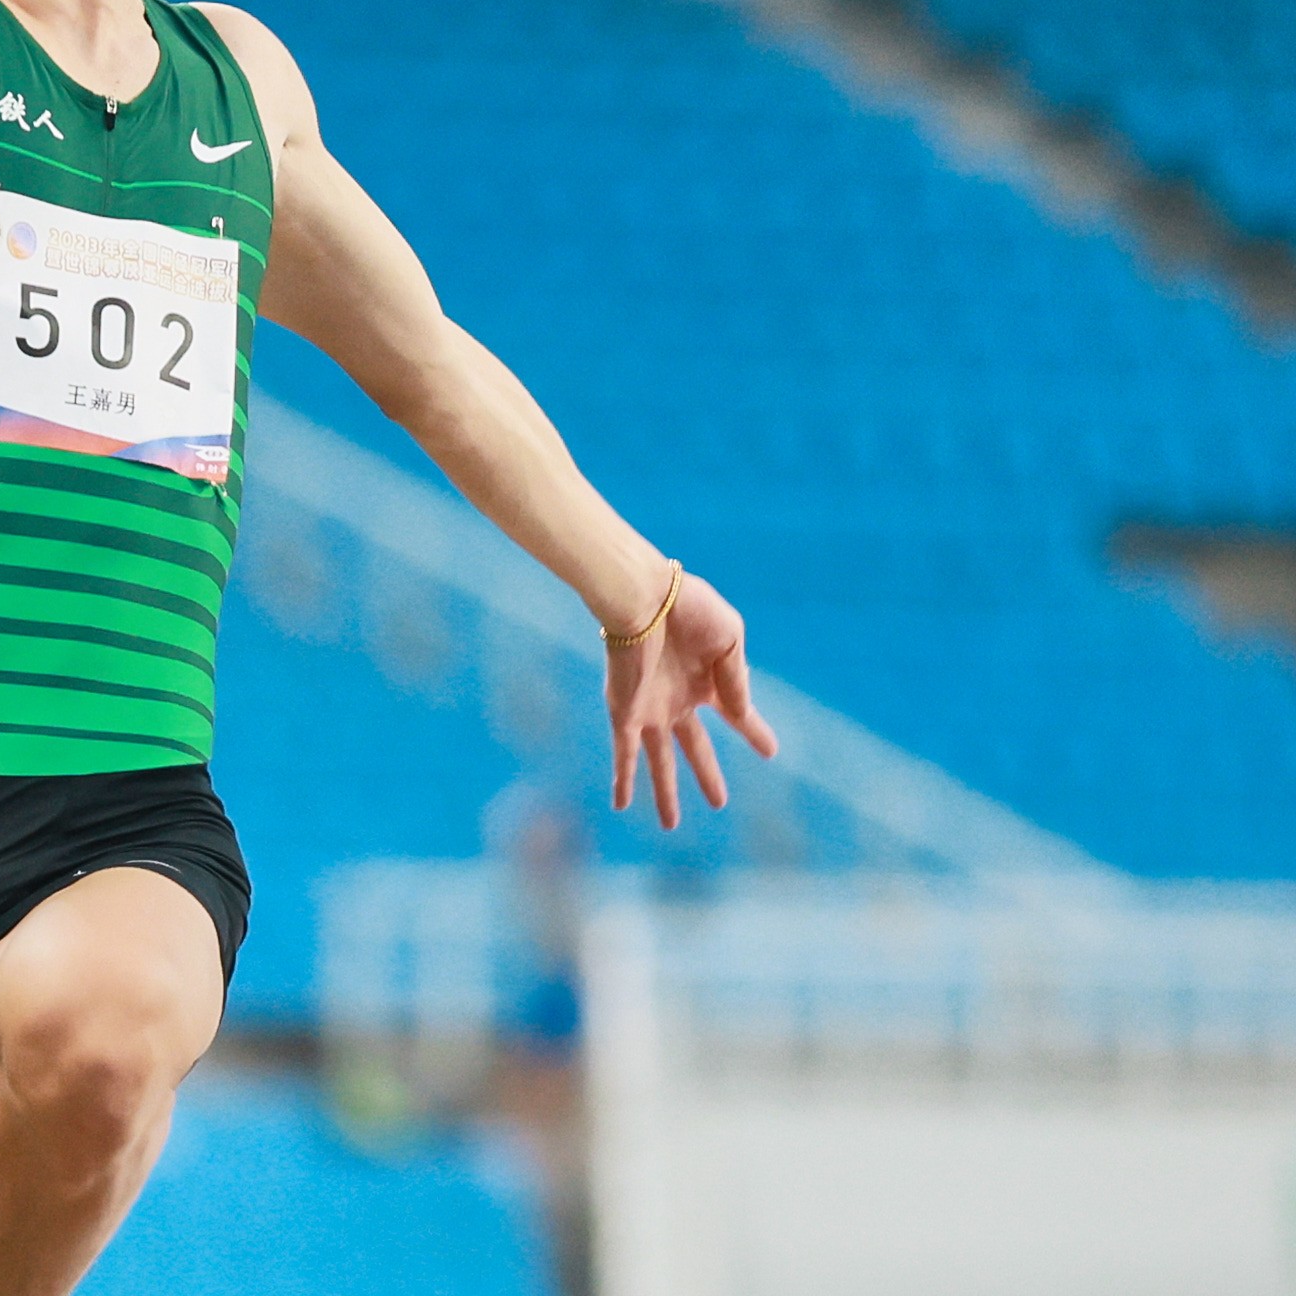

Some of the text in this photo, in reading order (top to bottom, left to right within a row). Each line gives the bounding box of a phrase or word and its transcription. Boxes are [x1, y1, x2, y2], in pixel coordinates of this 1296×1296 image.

[15, 283, 194, 391] 502
[64, 383, 136, 416] 王嘉男
